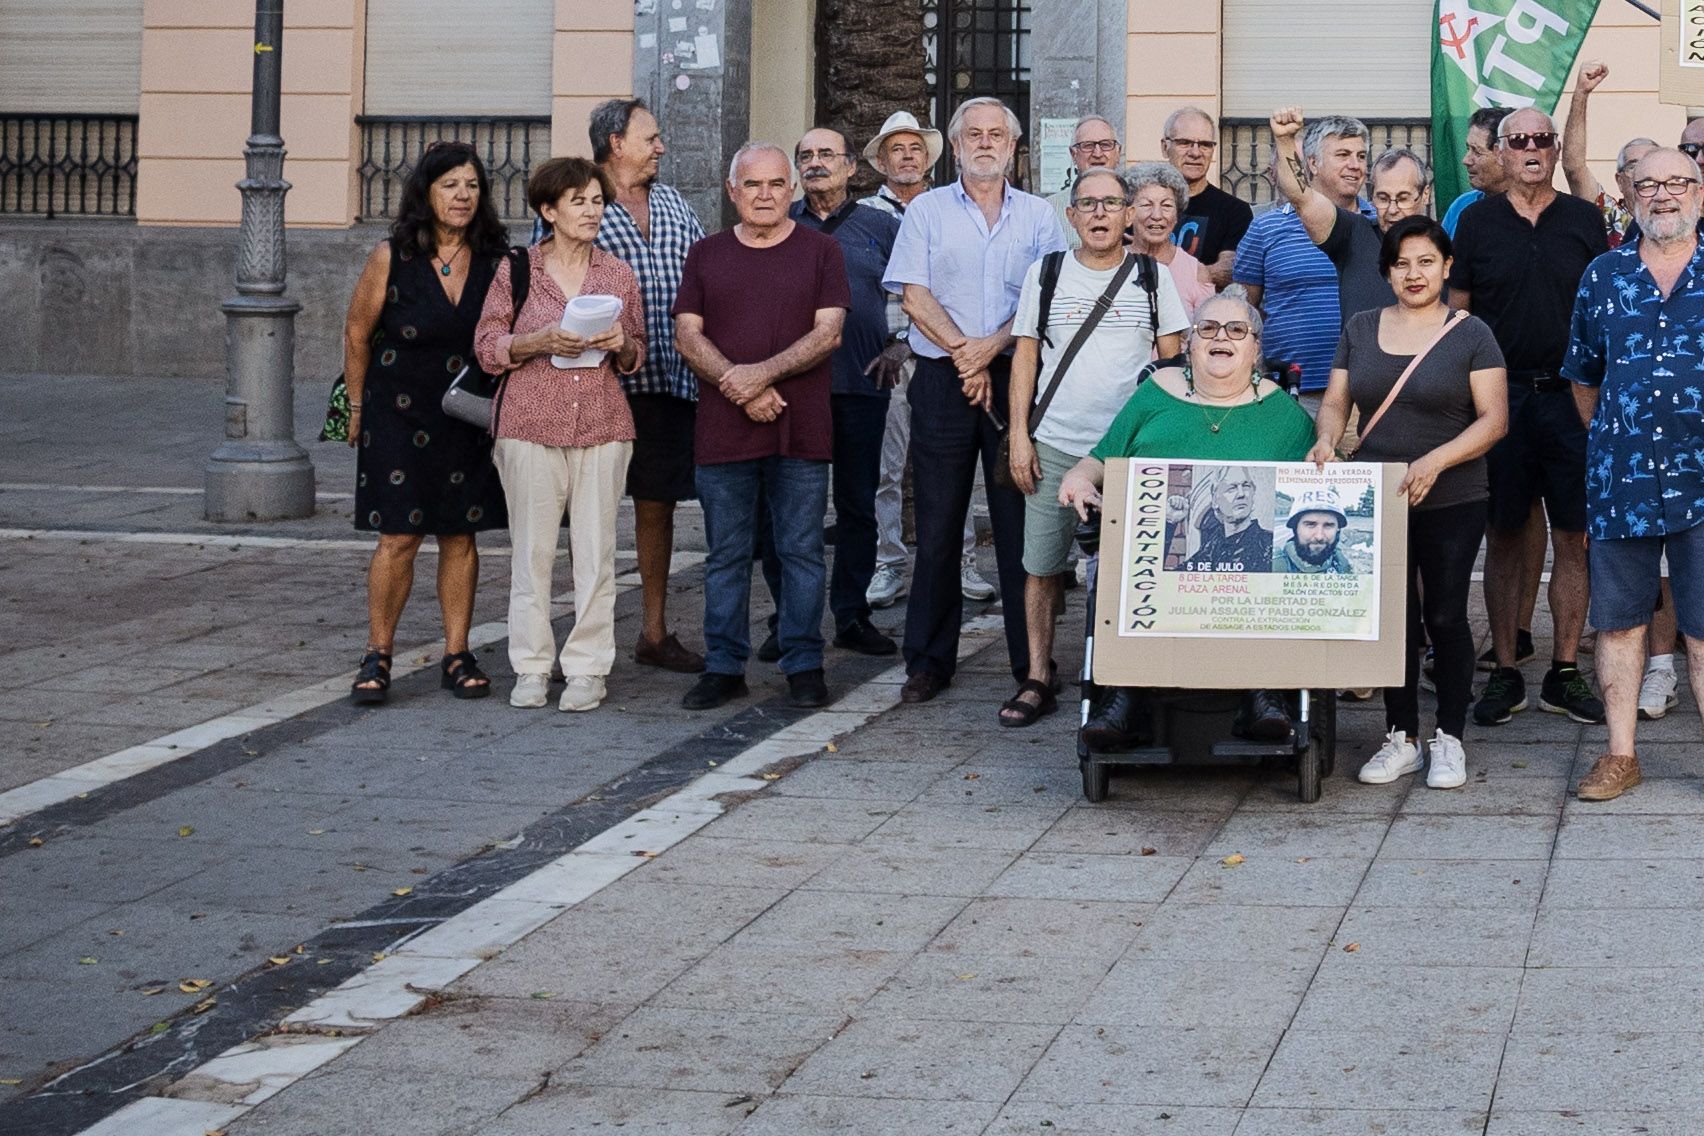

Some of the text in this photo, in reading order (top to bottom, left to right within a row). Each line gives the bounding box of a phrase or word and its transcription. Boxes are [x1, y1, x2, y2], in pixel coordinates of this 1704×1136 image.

[1186, 561, 1244, 571] 5 DE JULIO
[1177, 584, 1251, 593] PLAZA ARENAL
[1210, 595, 1325, 605] POR LA LIBERTAD DE
[1168, 606, 1366, 617] JULIAN ASSAGE Y PABLO GONZÁLEZ
